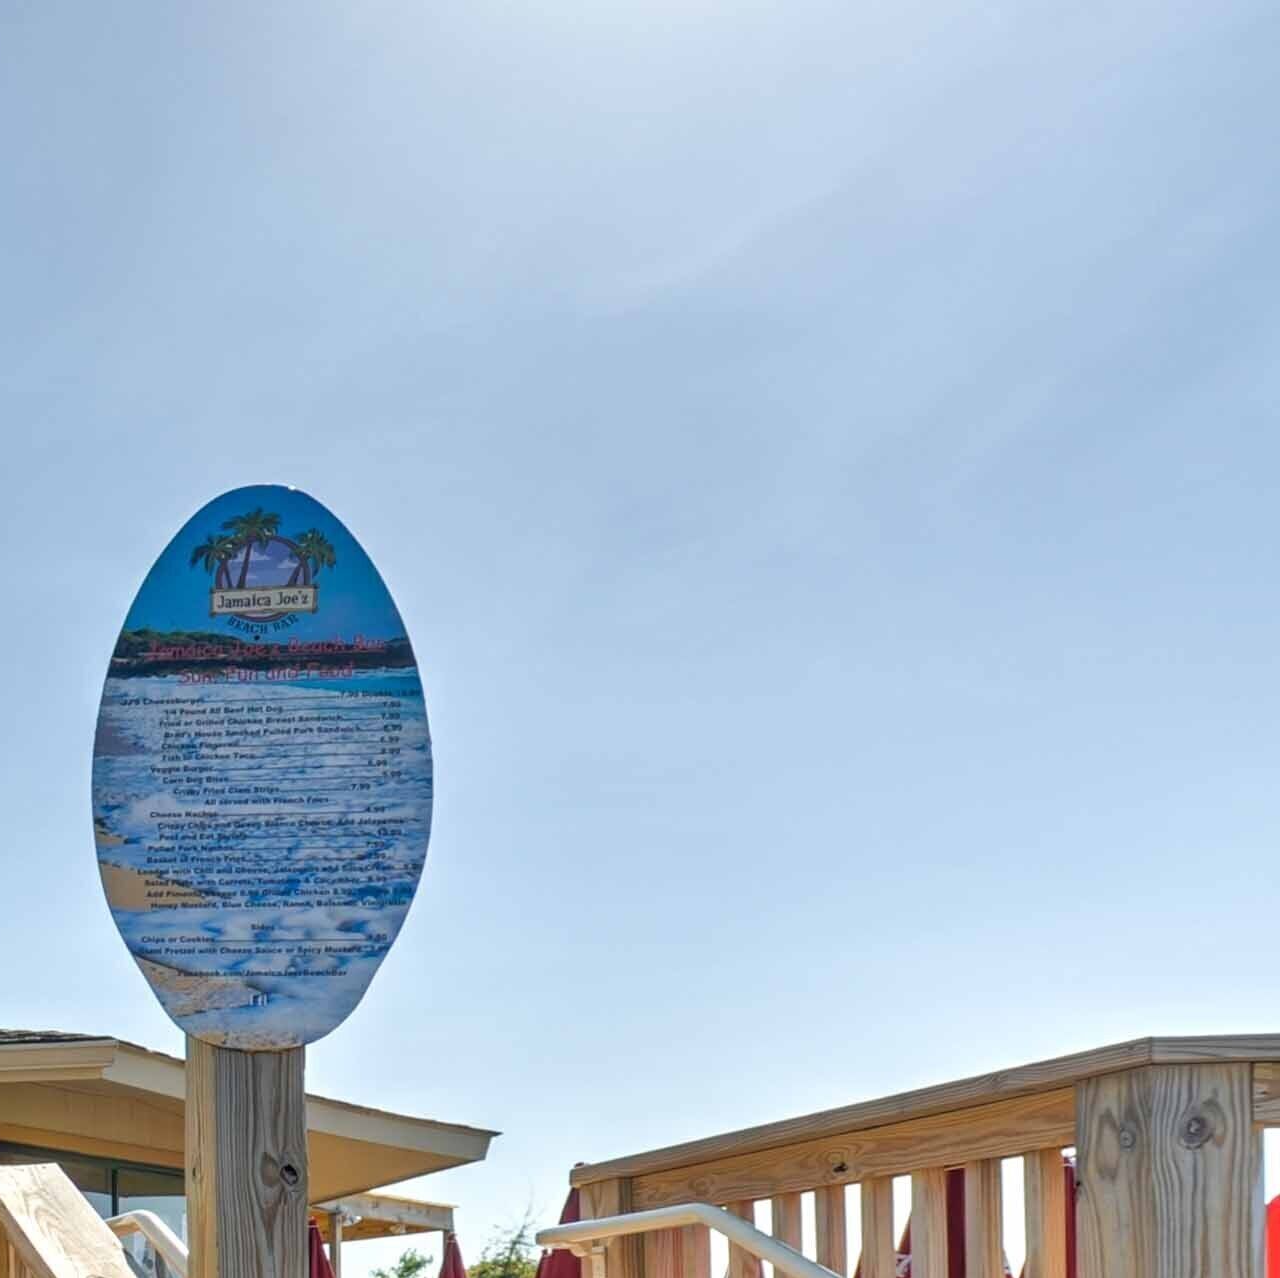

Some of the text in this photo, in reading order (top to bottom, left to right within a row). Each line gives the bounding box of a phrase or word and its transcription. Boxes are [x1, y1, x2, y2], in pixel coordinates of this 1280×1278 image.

[217, 591, 309, 609] Jamaica Joe'z
[228, 614, 299, 634] BEACH BAR
[149, 640, 225, 659] Jamaica
